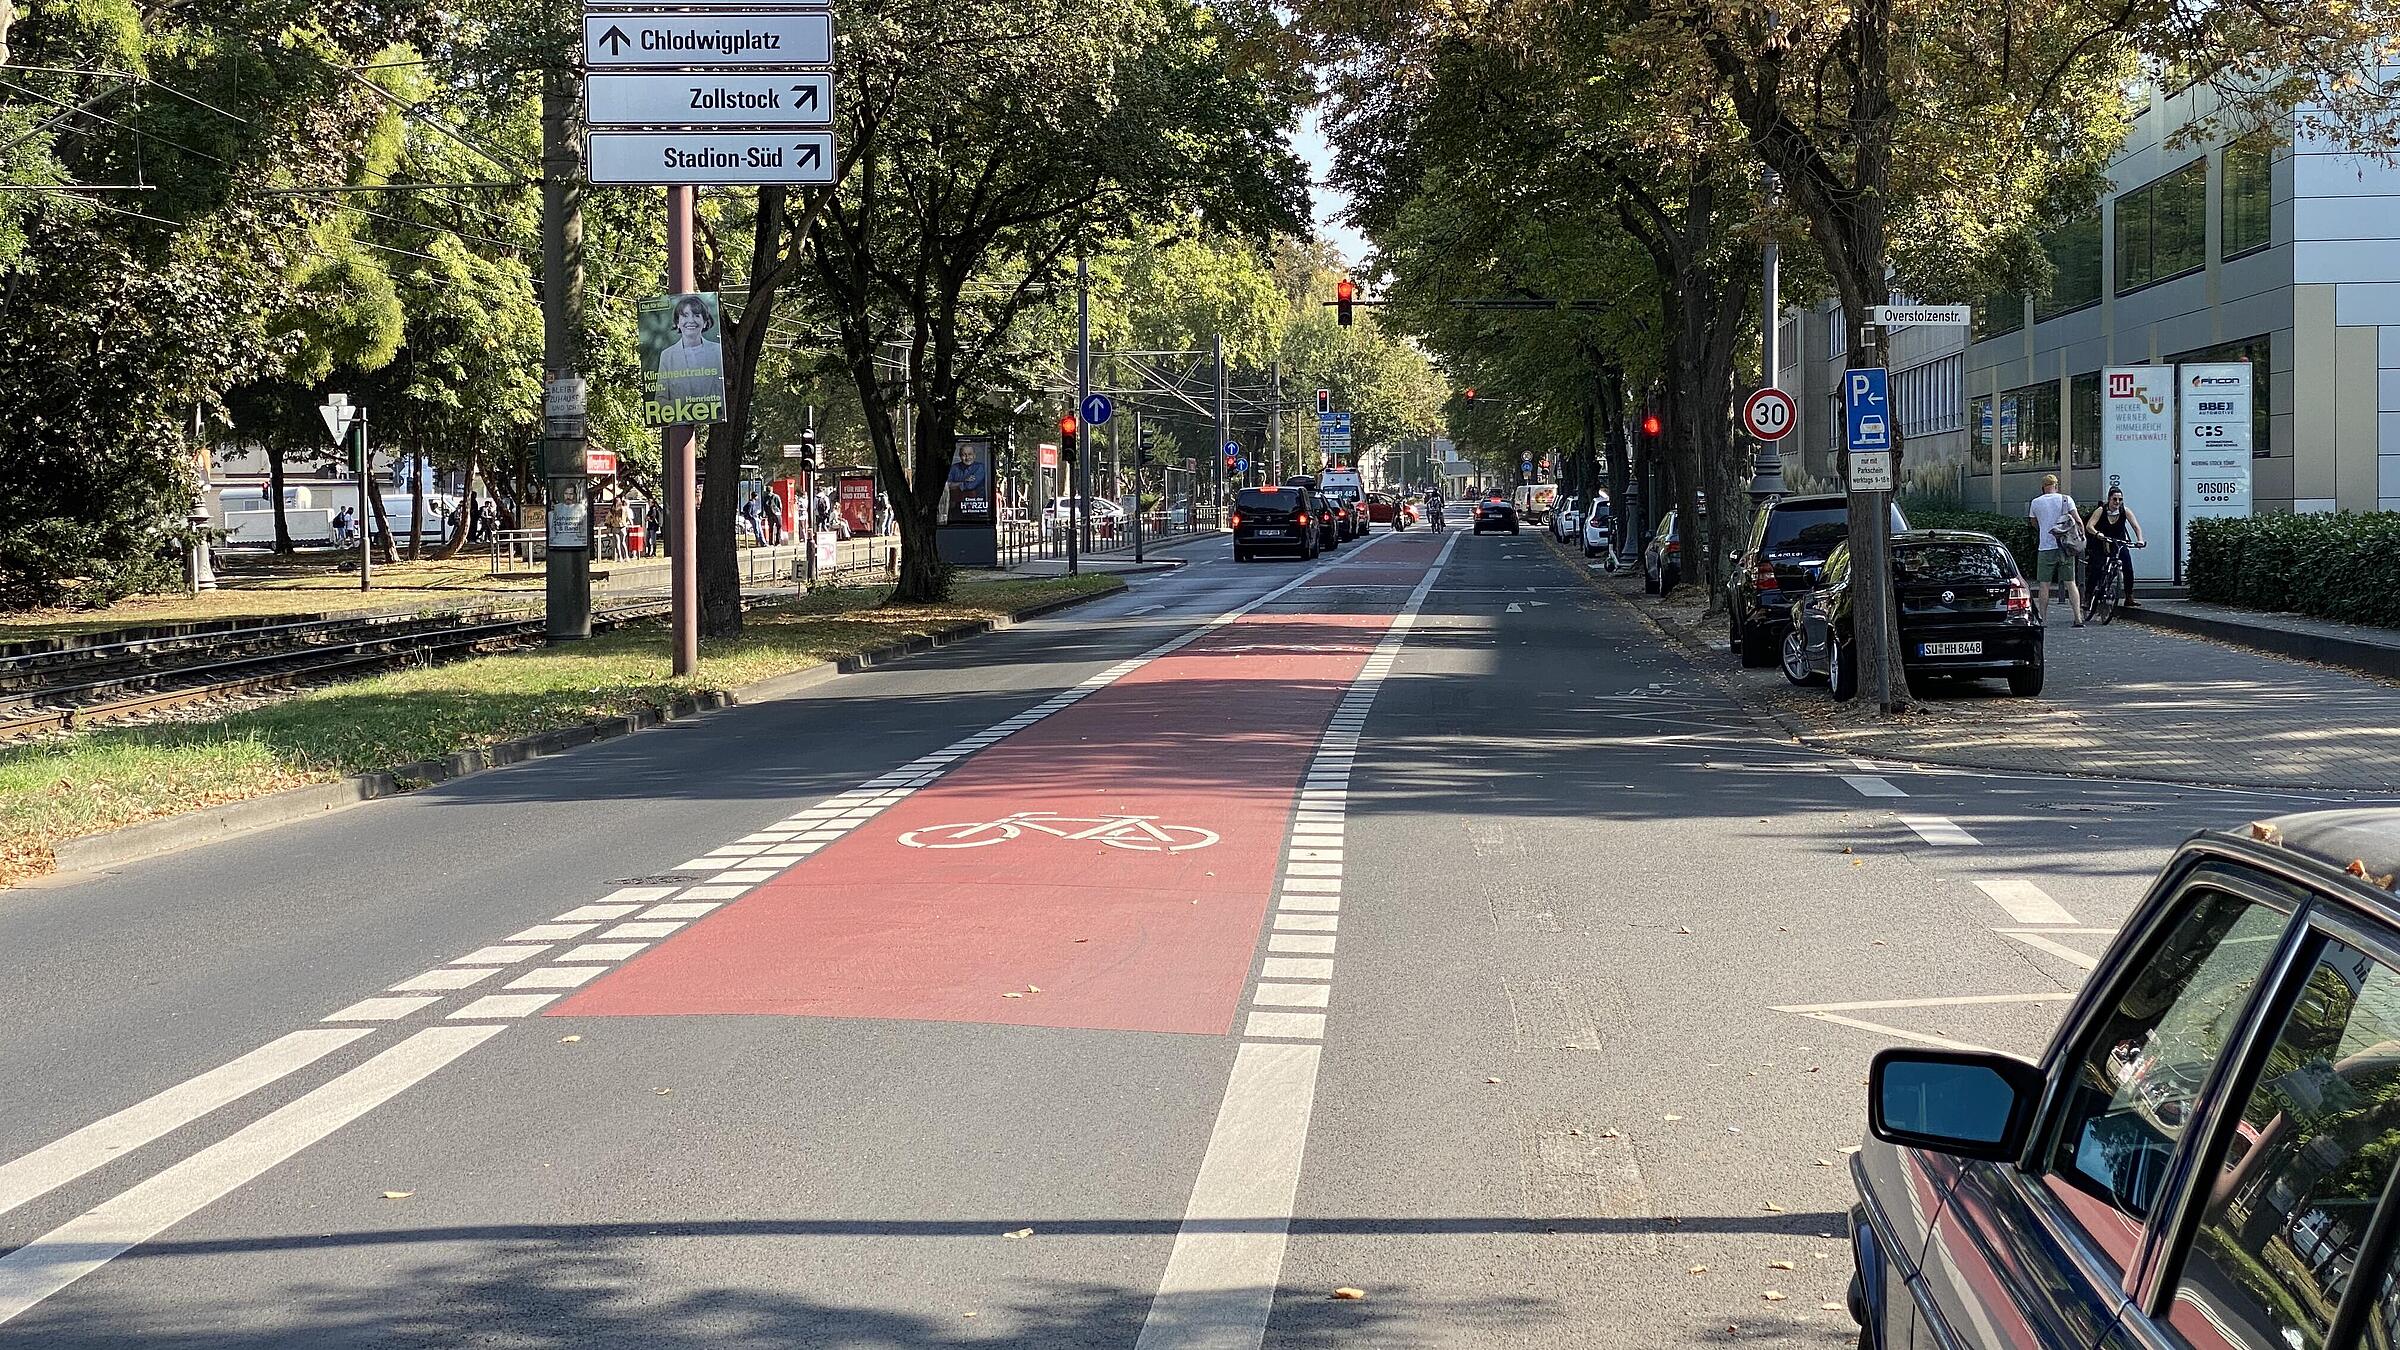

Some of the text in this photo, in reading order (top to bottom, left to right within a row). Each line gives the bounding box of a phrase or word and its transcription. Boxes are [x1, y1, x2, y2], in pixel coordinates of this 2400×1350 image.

[640, 29, 781, 55] Chlodwigplatz
[689, 88, 780, 109] Zollstock
[663, 147, 783, 168] Stadion-Süd
[1884, 309, 1961, 323] Overstolzenstr.
[643, 367, 718, 381] Klimaneutrales
[645, 382, 666, 393] Köln.
[1852, 375, 1870, 407] P
[685, 395, 721, 403] Henriette
[644, 398, 722, 425] Reker
[1755, 402, 1785, 426] 30
[2115, 404, 2141, 412] HECKER
[2115, 413, 2147, 421] WERNER
[2115, 423, 2162, 431] HIMMELREICH
[2115, 433, 2167, 441] RECHTSANWÄLTE
[1857, 466, 1884, 474] Parkschein
[2197, 482, 2236, 494] ensons
[796, 561, 803, 579] E
[1925, 642, 1981, 655] SU HH 8448
